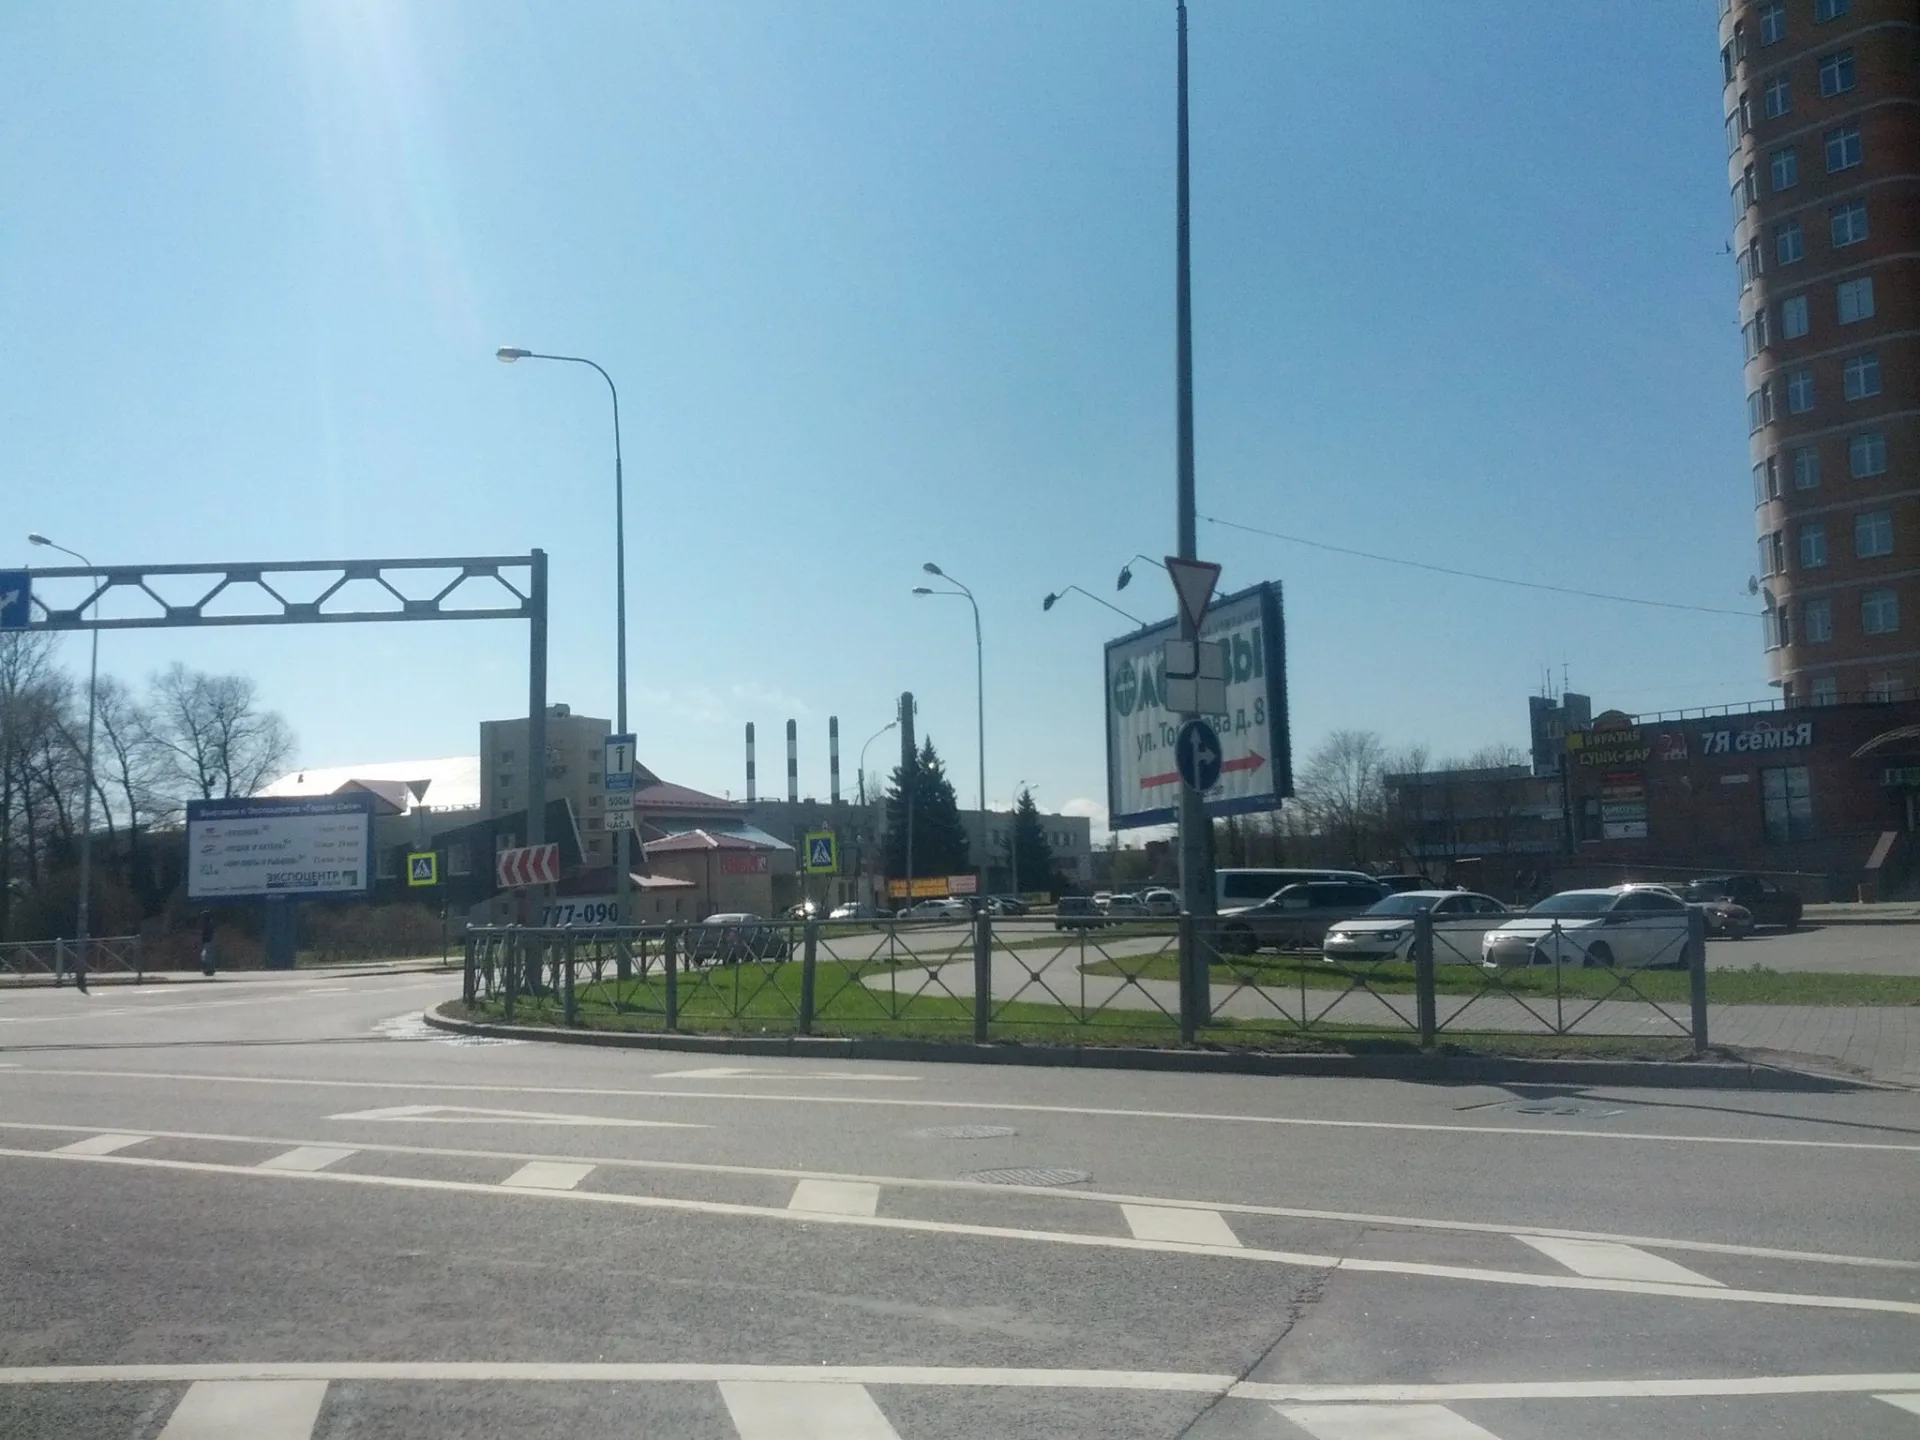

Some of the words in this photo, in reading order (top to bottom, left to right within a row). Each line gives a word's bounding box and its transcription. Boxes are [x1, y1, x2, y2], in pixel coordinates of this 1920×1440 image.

[1137, 732, 1157, 760] ул.
[1255, 697, 1265, 725] 8
[1702, 731, 1730, 753] 7Я
[266, 870, 339, 882] ЭКСПОЦЕНТР
